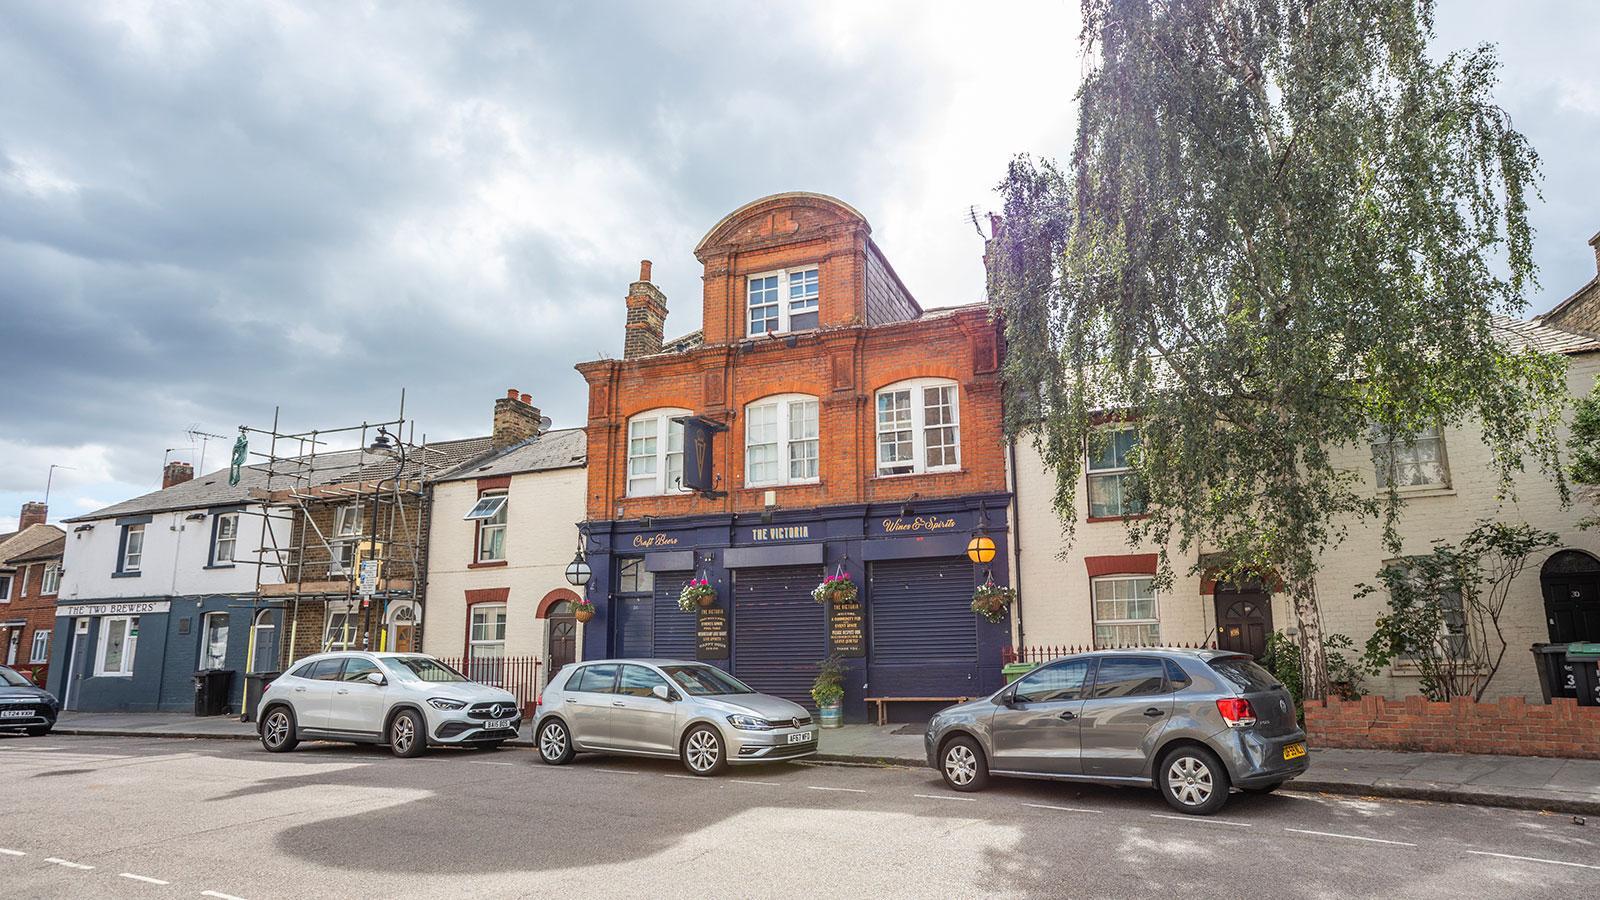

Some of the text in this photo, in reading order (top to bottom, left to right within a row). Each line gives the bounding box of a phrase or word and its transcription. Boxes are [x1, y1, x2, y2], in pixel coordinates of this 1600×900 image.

[882, 516, 956, 532] Wines & Spirits
[633, 532, 678, 547] Craft Beers
[752, 527, 808, 540] THE VICTORIA
[68, 606, 84, 614] THE
